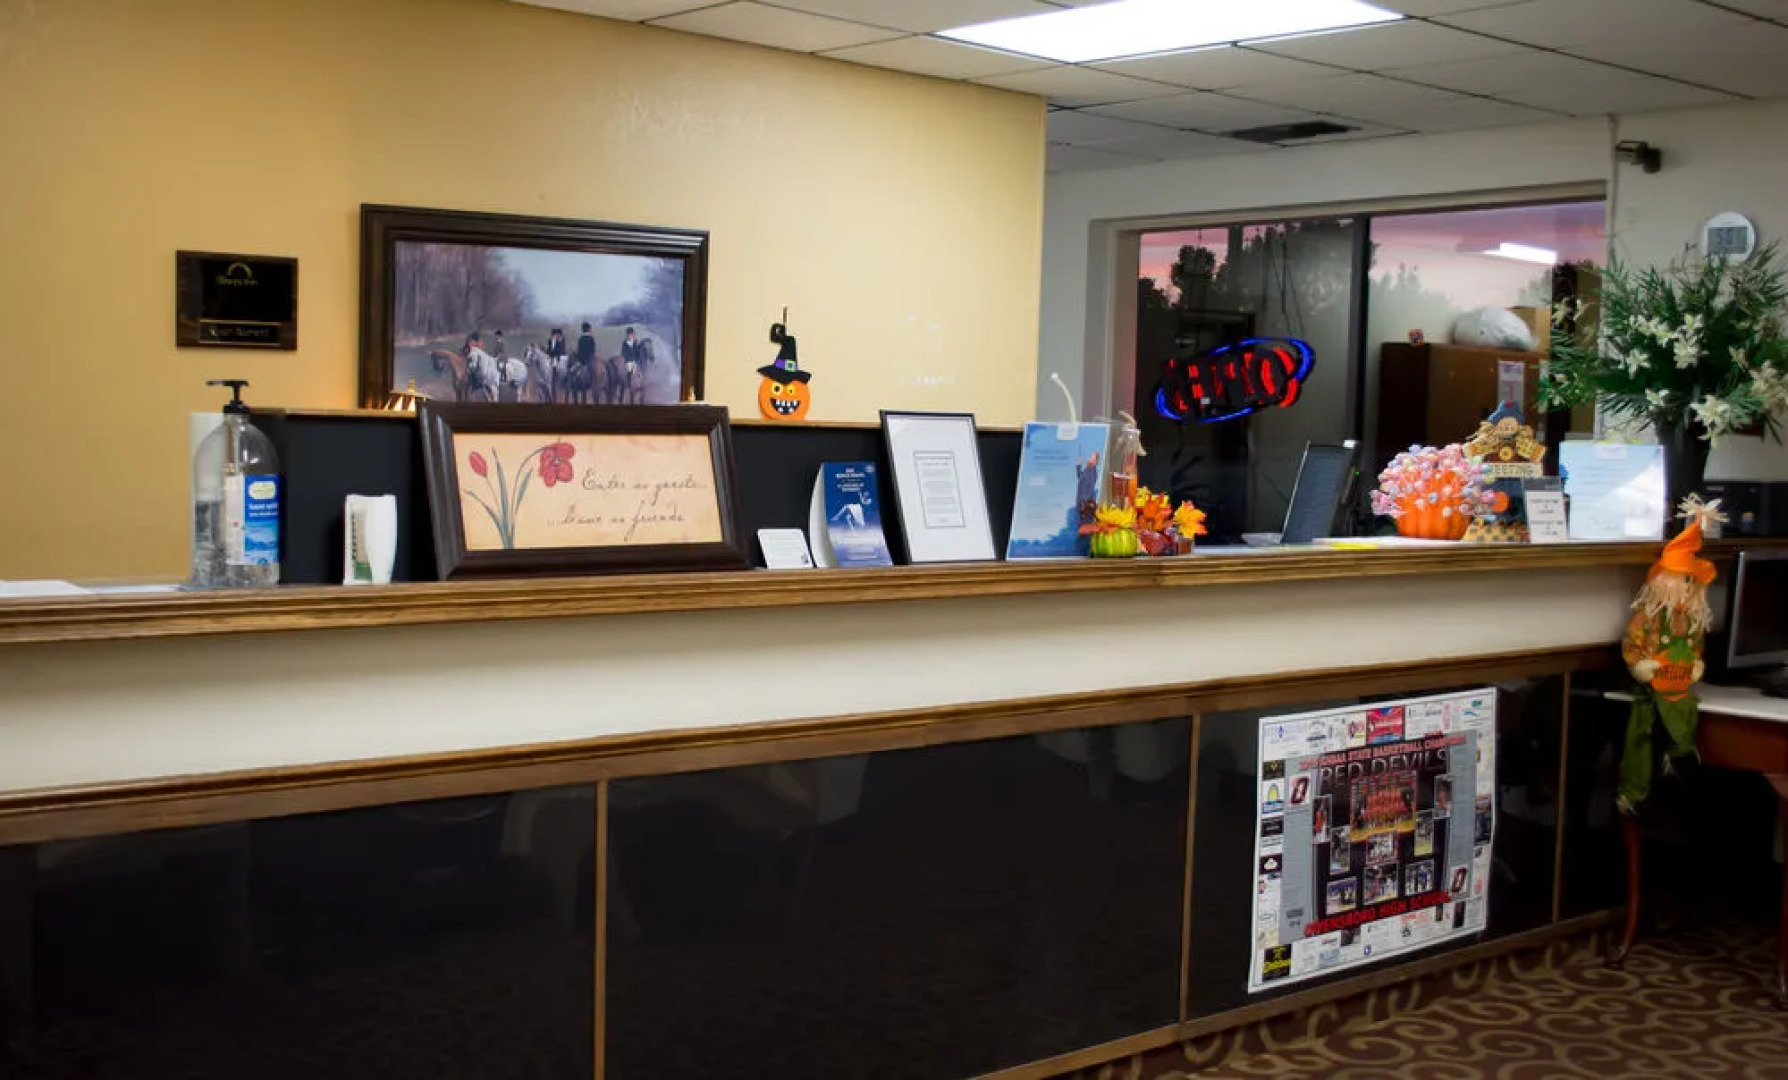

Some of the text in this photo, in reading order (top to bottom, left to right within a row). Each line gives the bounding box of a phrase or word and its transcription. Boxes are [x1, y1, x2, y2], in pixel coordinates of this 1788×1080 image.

[1320, 761, 1364, 783] RED
[1370, 748, 1448, 774] DEVILS
[1348, 748, 1372, 761] STATE
[1372, 740, 1423, 757] BASKETBALL
[1304, 907, 1377, 938] OWENSBORO
[1379, 900, 1407, 917] HIGH
